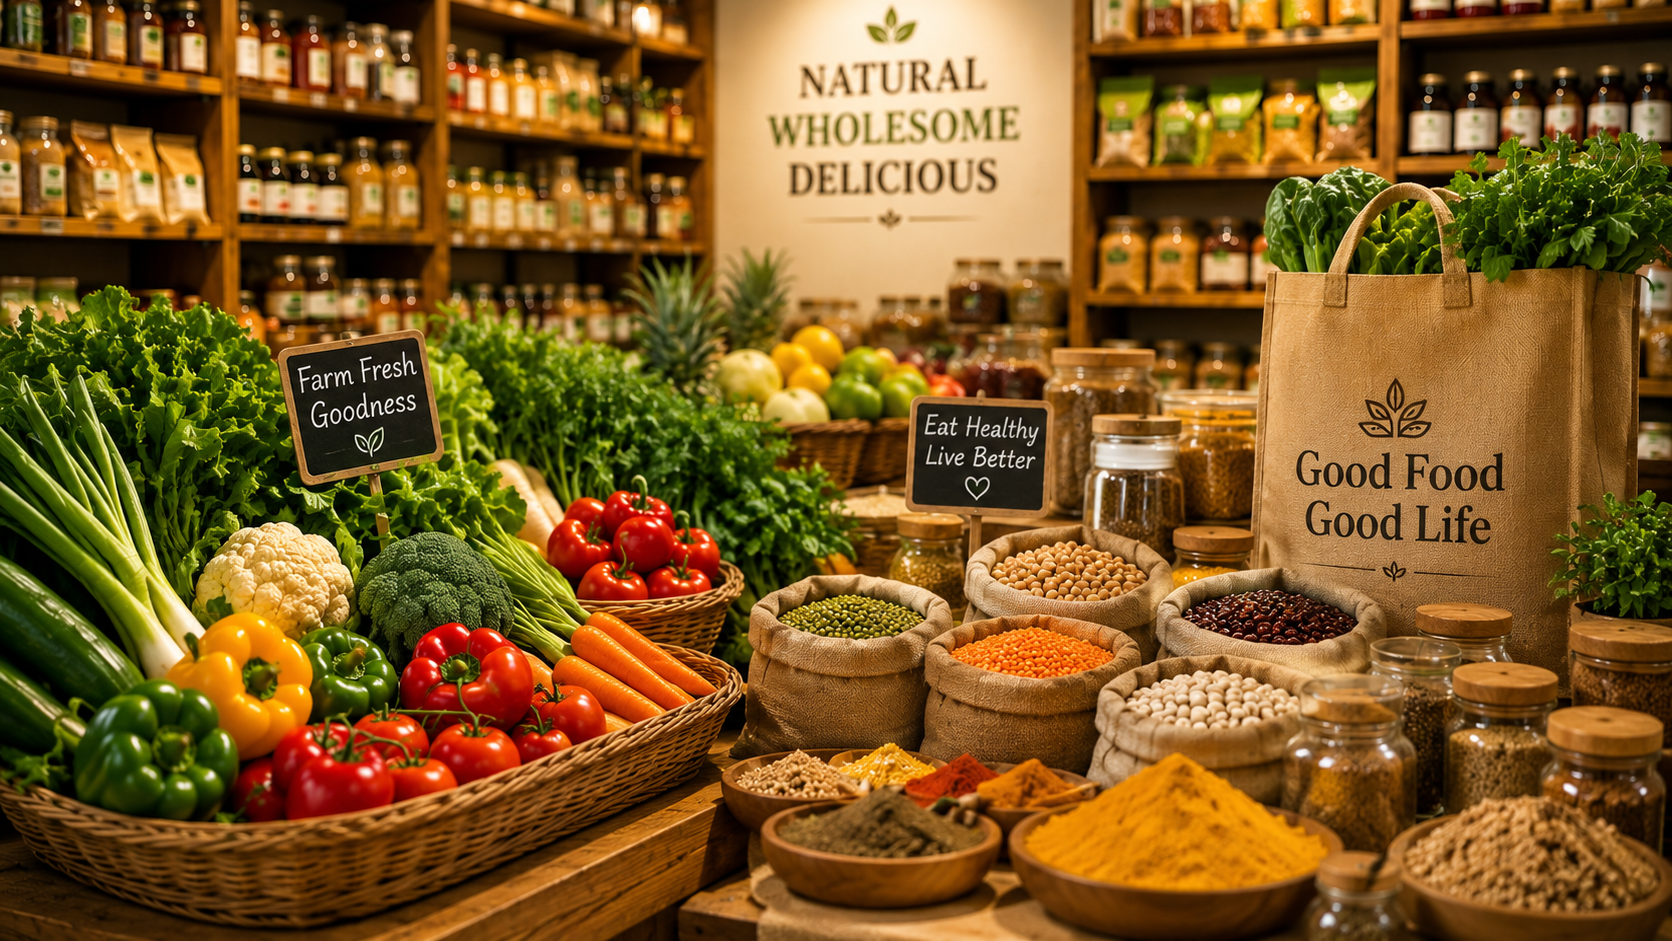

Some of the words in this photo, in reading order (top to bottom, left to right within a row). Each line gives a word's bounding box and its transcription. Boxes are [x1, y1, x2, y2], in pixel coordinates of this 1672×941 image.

[800, 56, 987, 98] NATURAL
[767, 106, 1021, 148] WHOLESOME
[788, 158, 998, 196] DELICIOUS
[298, 365, 354, 393] Farm
[359, 351, 417, 383] Fresh
[310, 392, 417, 429] Goodness
[924, 414, 959, 436] Eat
[966, 416, 1039, 446] Healthy
[925, 445, 964, 466] Live
[973, 446, 1036, 469] Better
[1296, 450, 1392, 489] Good
[1405, 453, 1505, 491] Food
[1305, 500, 1403, 541] Good
[1415, 505, 1491, 544] Life
